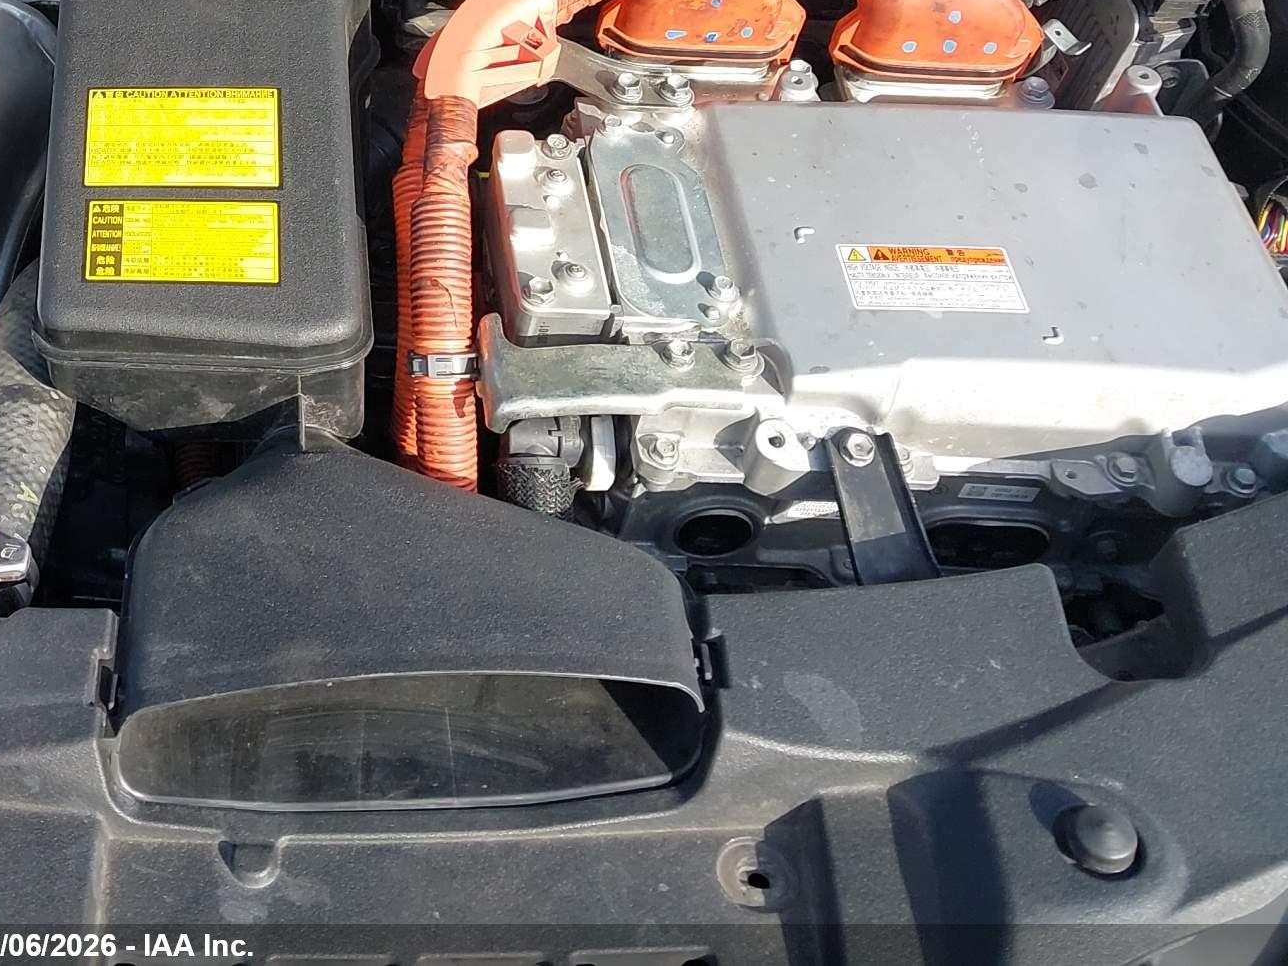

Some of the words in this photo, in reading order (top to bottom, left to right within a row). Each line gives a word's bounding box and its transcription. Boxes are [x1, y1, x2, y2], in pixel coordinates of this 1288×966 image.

[125, 90, 168, 99] CAUTION
[170, 90, 224, 99] ATTENTION
[92, 216, 123, 225] CAUTION
[92, 229, 122, 239] ATTENTION
[887, 247, 930, 257] WARNING
[891, 255, 943, 263] AVERTISSEMENT
